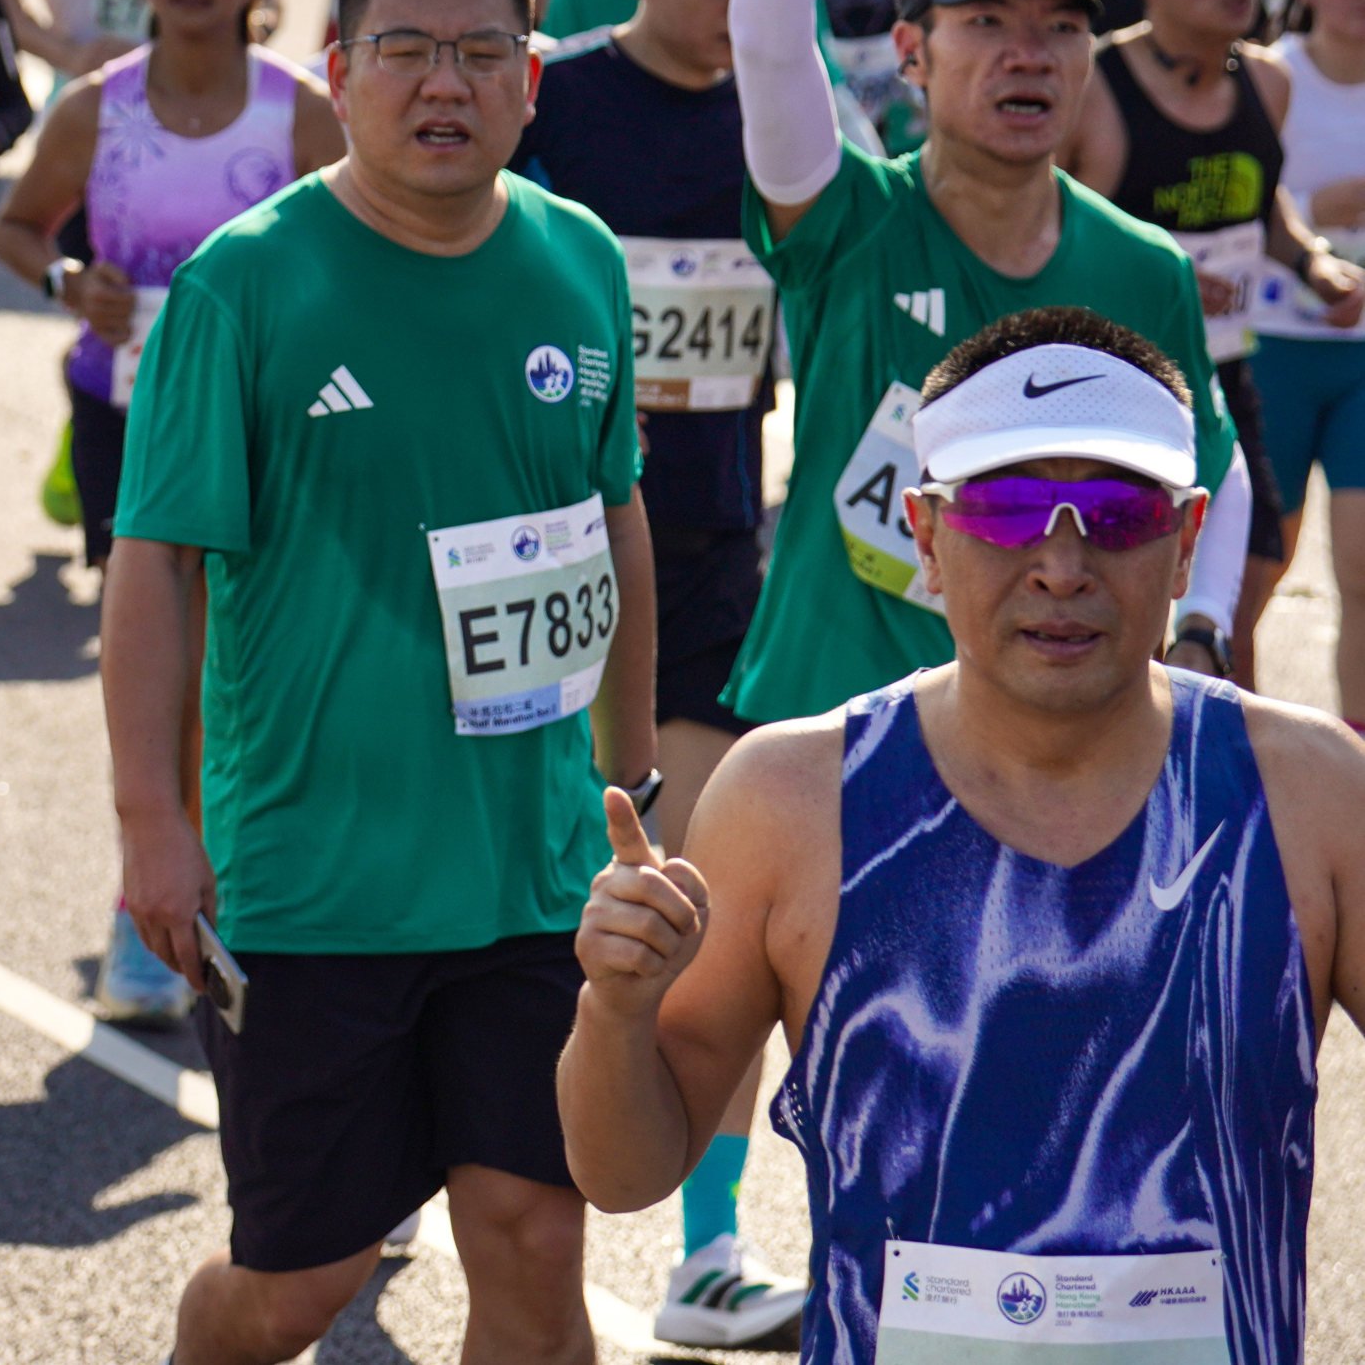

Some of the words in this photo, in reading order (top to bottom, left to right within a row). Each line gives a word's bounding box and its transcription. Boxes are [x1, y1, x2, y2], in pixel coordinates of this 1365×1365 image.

[632, 304, 765, 361] G2414
[459, 571, 615, 676] E7833
[1055, 1274, 1093, 1282] Standard
[1055, 1283, 1096, 1291] Chartered
[1160, 1286, 1196, 1295] HKAAA
